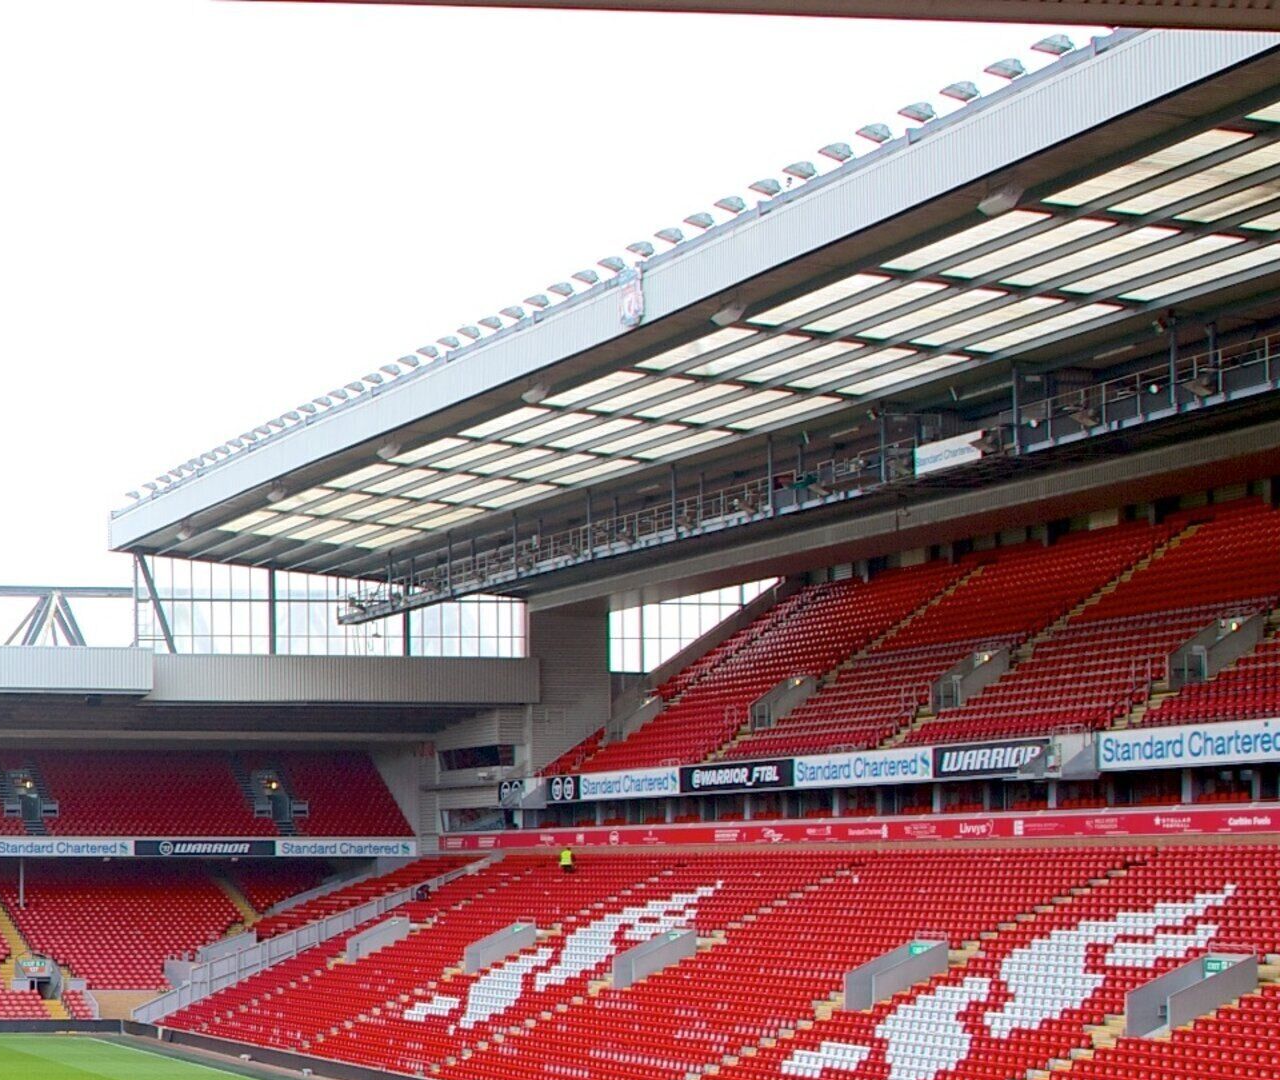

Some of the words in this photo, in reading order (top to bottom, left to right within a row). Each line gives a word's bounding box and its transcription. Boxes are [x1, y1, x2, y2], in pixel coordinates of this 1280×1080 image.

[1103, 733, 1184, 763] Standard
[692, 766, 780, 788] @WARRIOR_FTBL
[797, 758, 851, 782] Standard
[853, 754, 918, 778] Chartered
[582, 776, 621, 795] Standard
[623, 773, 668, 793] Chartered
[57, 842, 117, 855] Chartered
[174, 843, 250, 854] WARRIOR
[282, 843, 337, 855] Standard
[340, 843, 400, 855] Chartered
